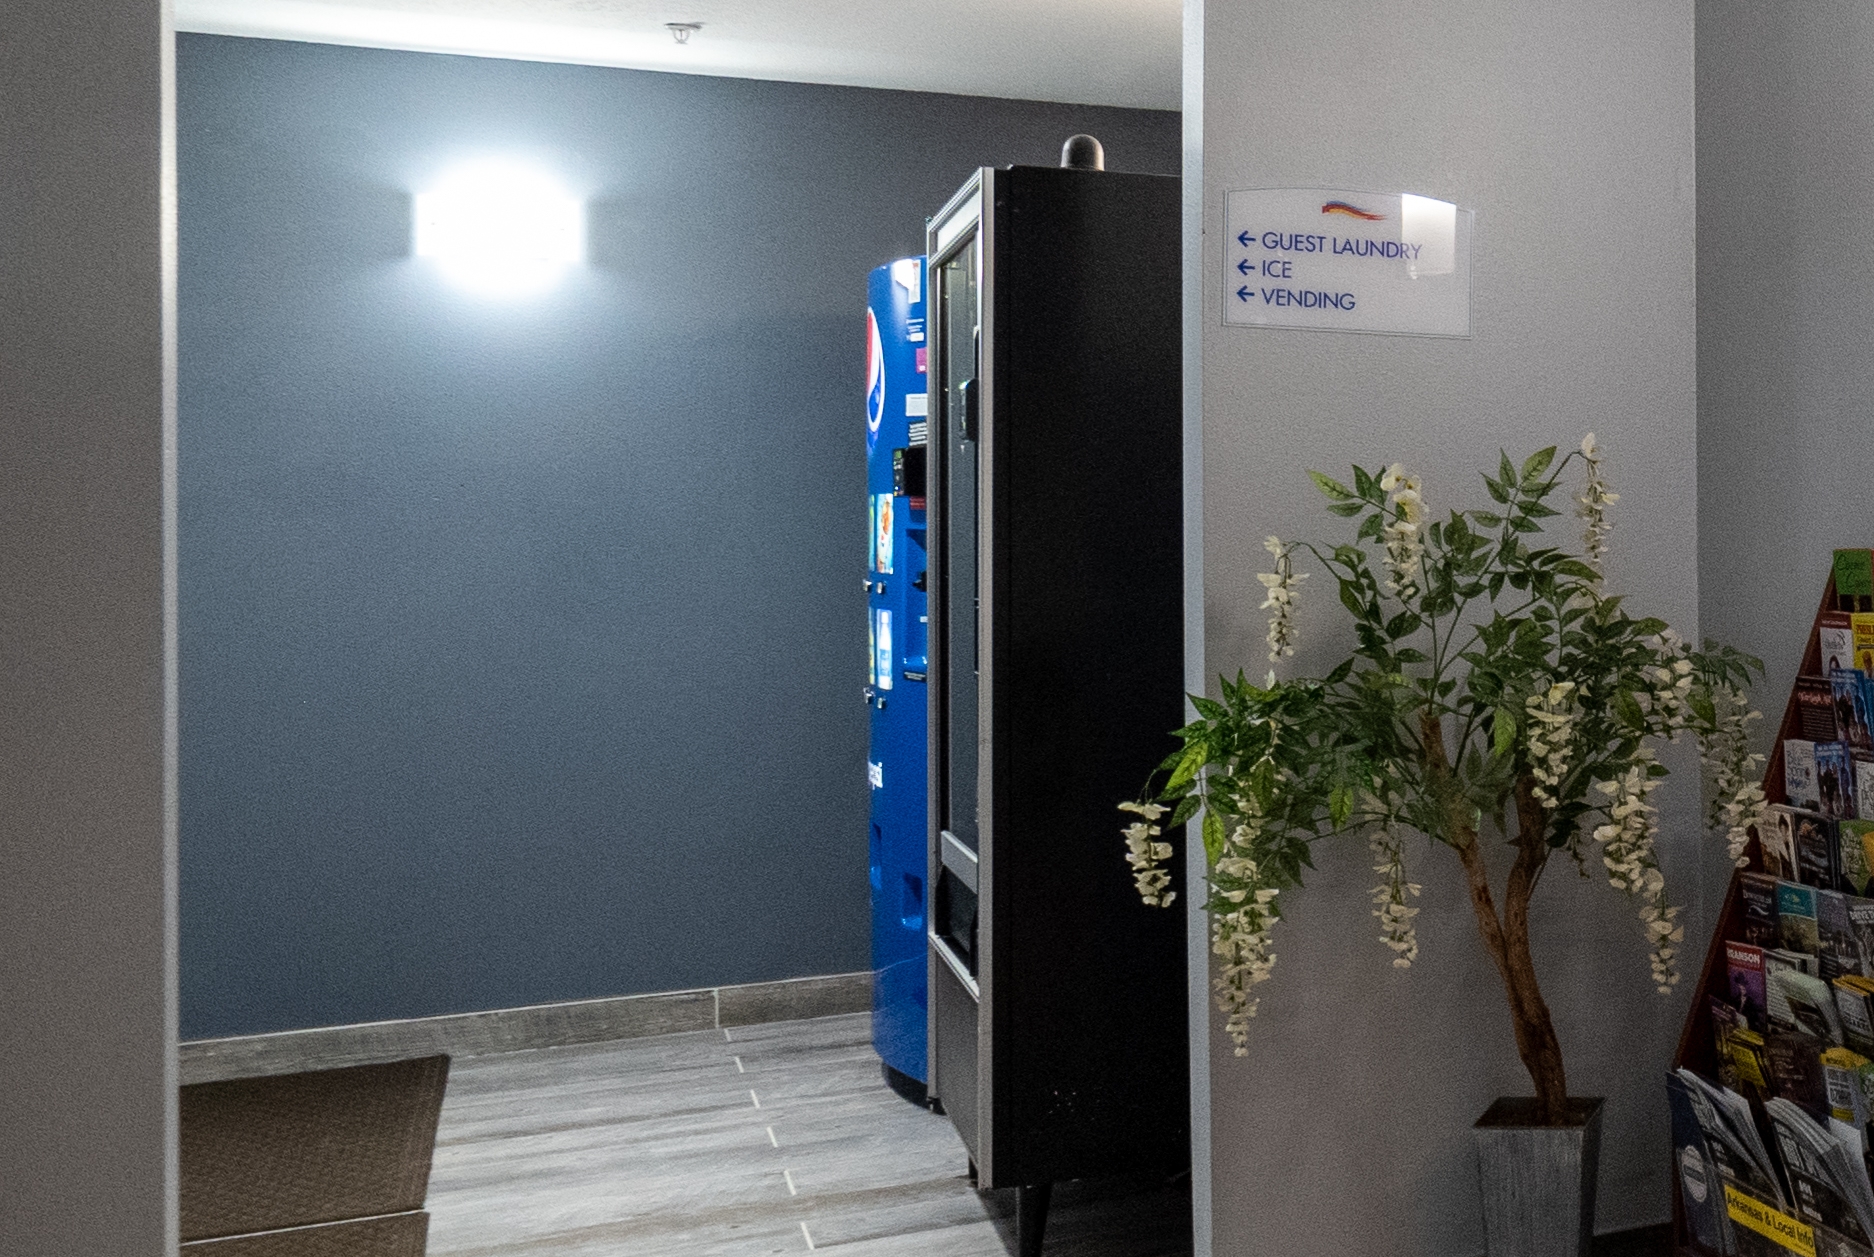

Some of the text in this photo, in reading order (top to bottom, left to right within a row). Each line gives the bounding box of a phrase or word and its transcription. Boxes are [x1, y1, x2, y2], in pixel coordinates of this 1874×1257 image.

[1262, 231, 1422, 260] GUEST LAUNDRY
[1262, 260, 1292, 278] ICE
[1262, 288, 1356, 310] VENDING
[1727, 1191, 1814, 1249] Arkansas & Local Info
